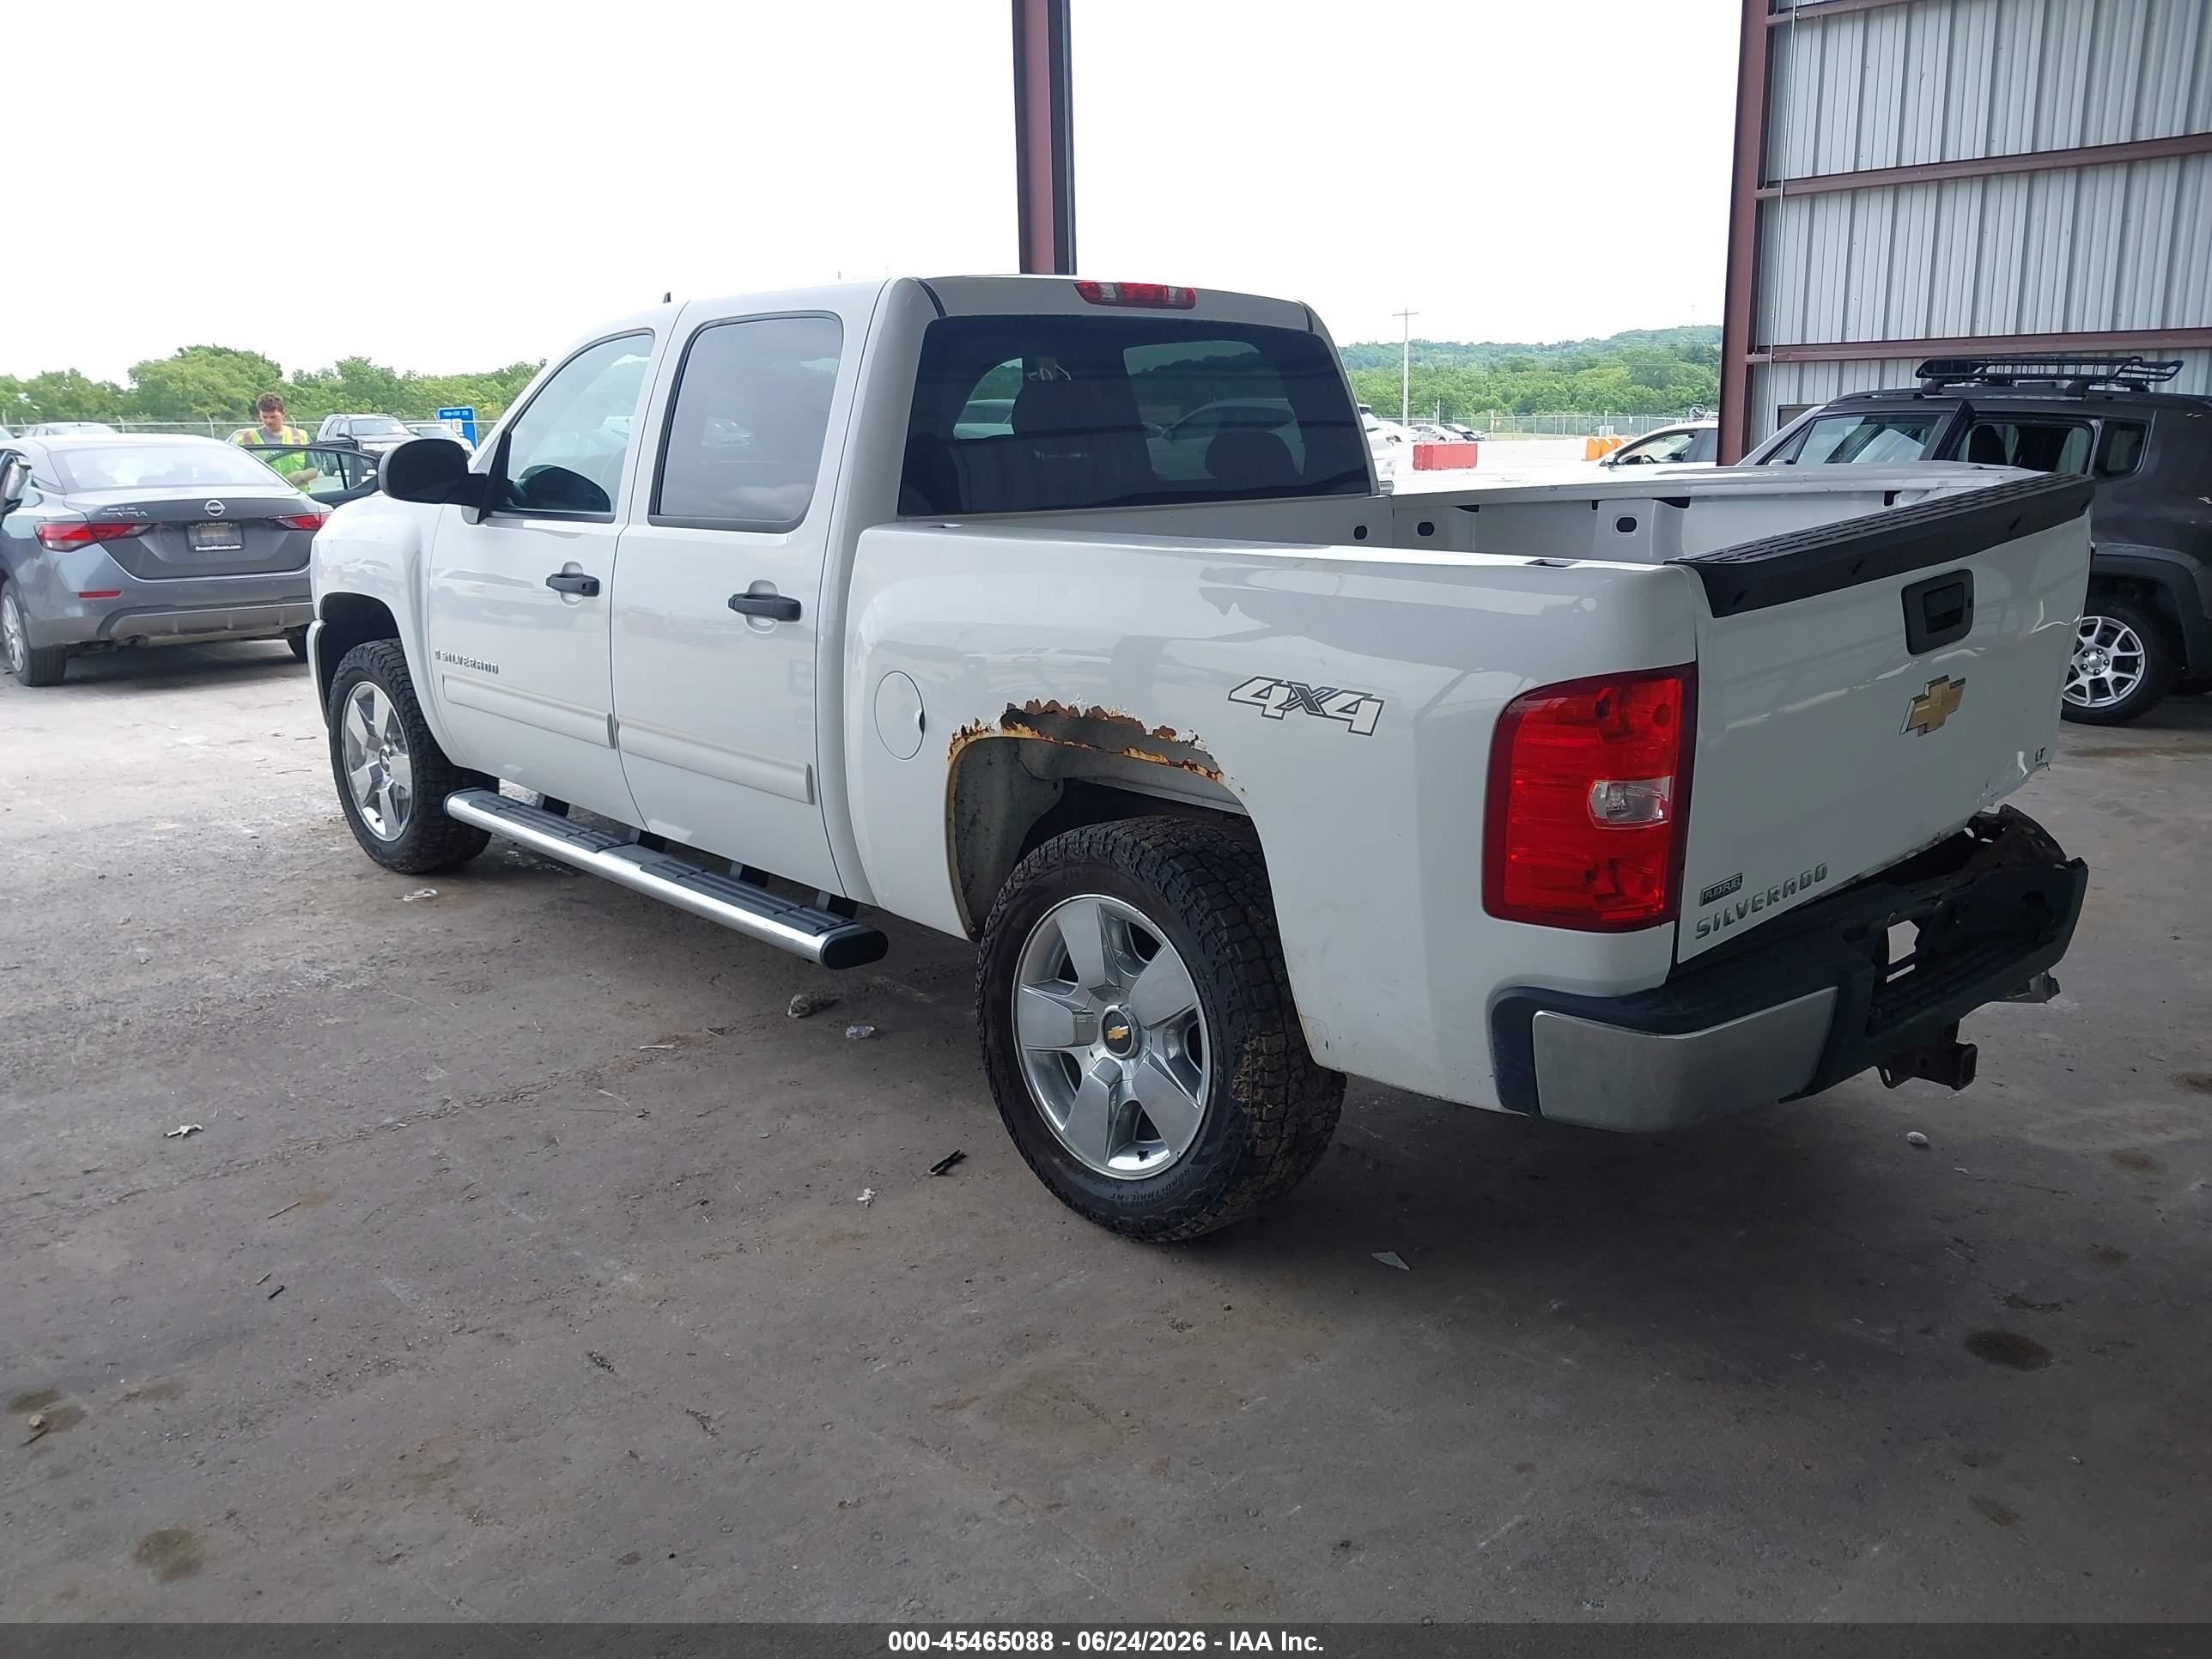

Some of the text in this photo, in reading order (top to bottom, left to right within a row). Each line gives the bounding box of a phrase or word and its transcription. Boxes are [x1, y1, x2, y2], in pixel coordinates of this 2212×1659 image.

[1227, 675, 1385, 737] 4X4
[2035, 747, 2046, 763] LT
[1695, 862, 1828, 940] SILVERADO
